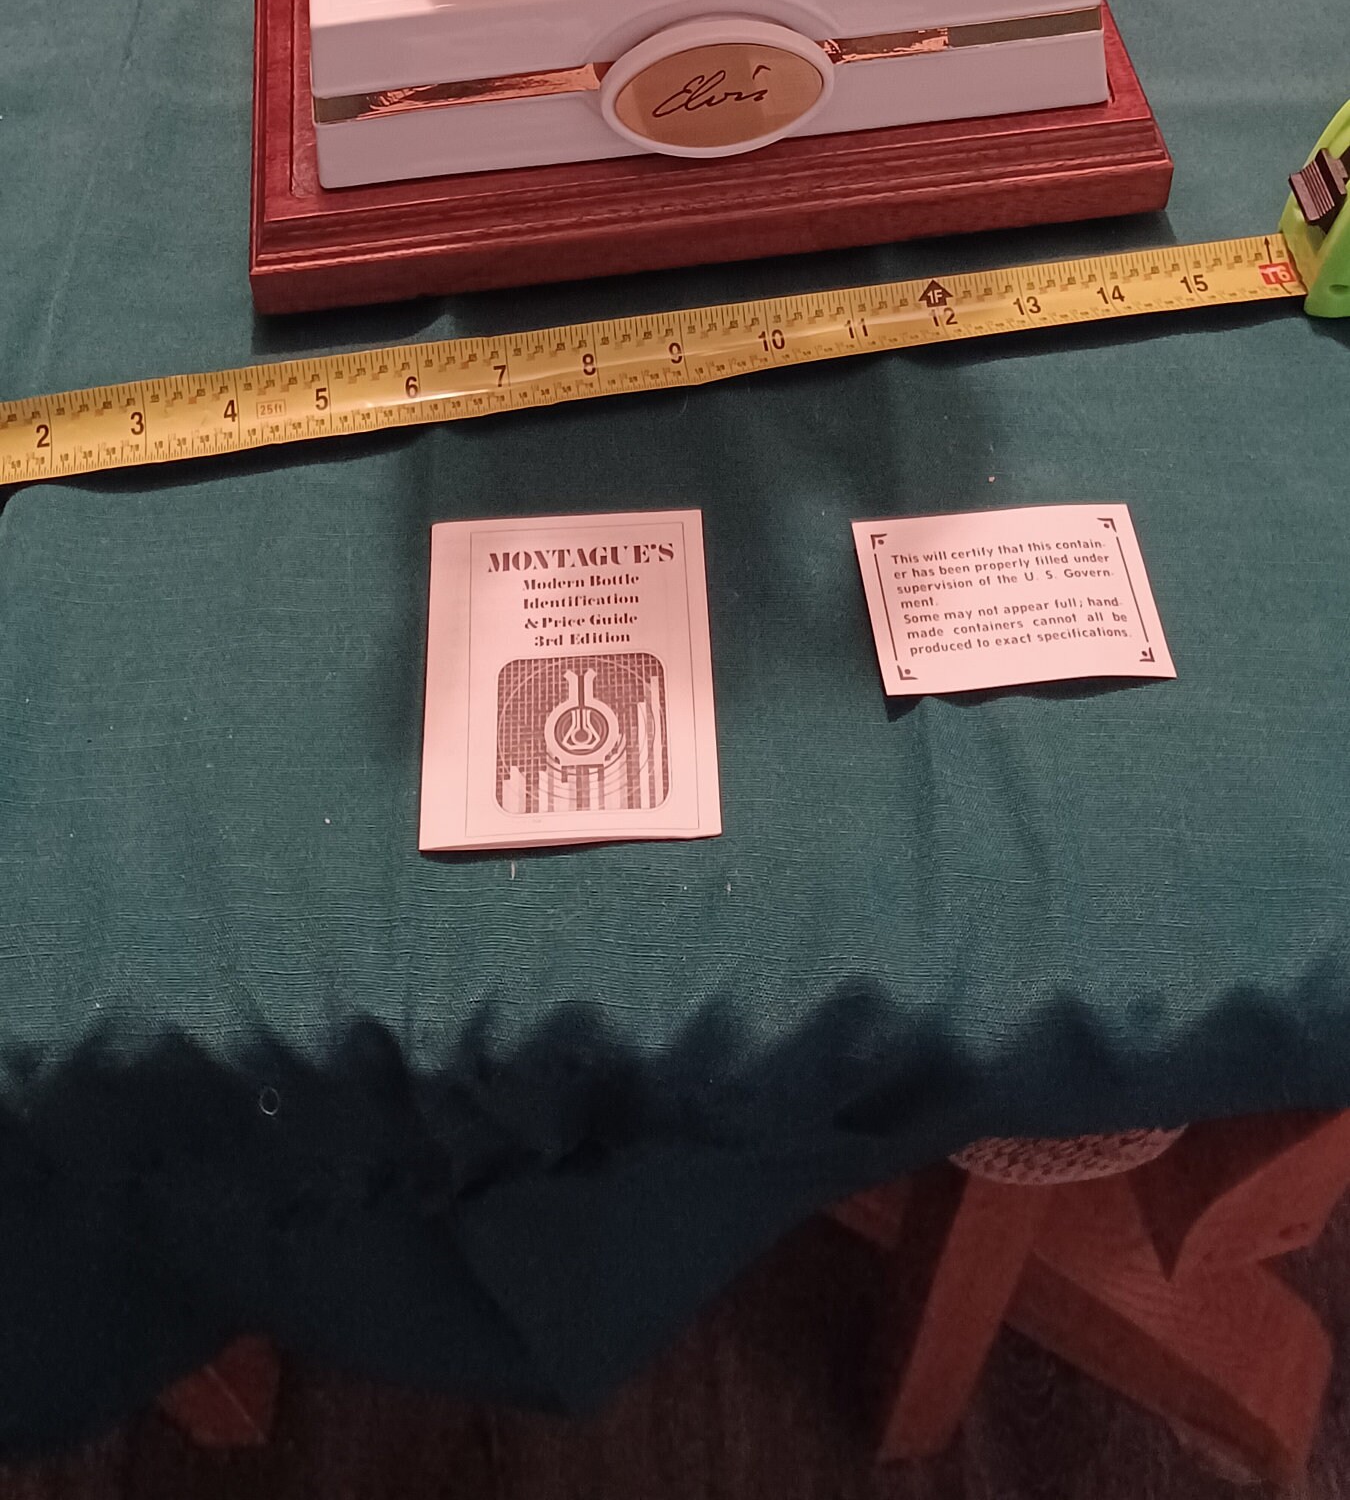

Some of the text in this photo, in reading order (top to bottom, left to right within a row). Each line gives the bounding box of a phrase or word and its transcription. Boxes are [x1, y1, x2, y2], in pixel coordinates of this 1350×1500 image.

[652, 65, 771, 118] Elvis
[926, 289, 943, 303] 1F
[35, 424, 50, 448] 2
[130, 412, 144, 435] 3
[223, 399, 237, 422] 4
[315, 388, 328, 410] 5
[405, 376, 418, 398] 6
[493, 365, 506, 388] 7
[582, 354, 596, 375] 8
[669, 342, 683, 364] 9
[758, 329, 785, 351] 10
[844, 318, 869, 338] 11
[929, 308, 958, 327] 12
[1013, 296, 1042, 315] 13
[1096, 285, 1125, 305] 14
[1180, 274, 1209, 294] 15
[260, 403, 283, 416] 25ft
[488, 543, 675, 573] MONTAGUE'S
[891, 553, 919, 565] This
[922, 551, 947, 562] will
[951, 546, 993, 559] certify
[998, 543, 1024, 555] that
[1028, 541, 1052, 552] this
[894, 553, 1109, 580] er has been properly filled under
[523, 573, 640, 591] Modern Bottle
[896, 579, 973, 594] supervision
[978, 575, 991, 586] of
[997, 574, 1018, 584] the
[523, 593, 640, 610] Identification
[524, 613, 638, 630] & Price Guide
[903, 613, 940, 625] Some
[944, 609, 972, 620] may
[978, 605, 998, 617] not
[1003, 602, 1049, 615] appear
[907, 611, 1128, 639] made containers cannot all be
[534, 631, 631, 647] 3rd Edition
[910, 639, 972, 657] produced
[977, 638, 990, 648] to
[995, 633, 1031, 646] exact
